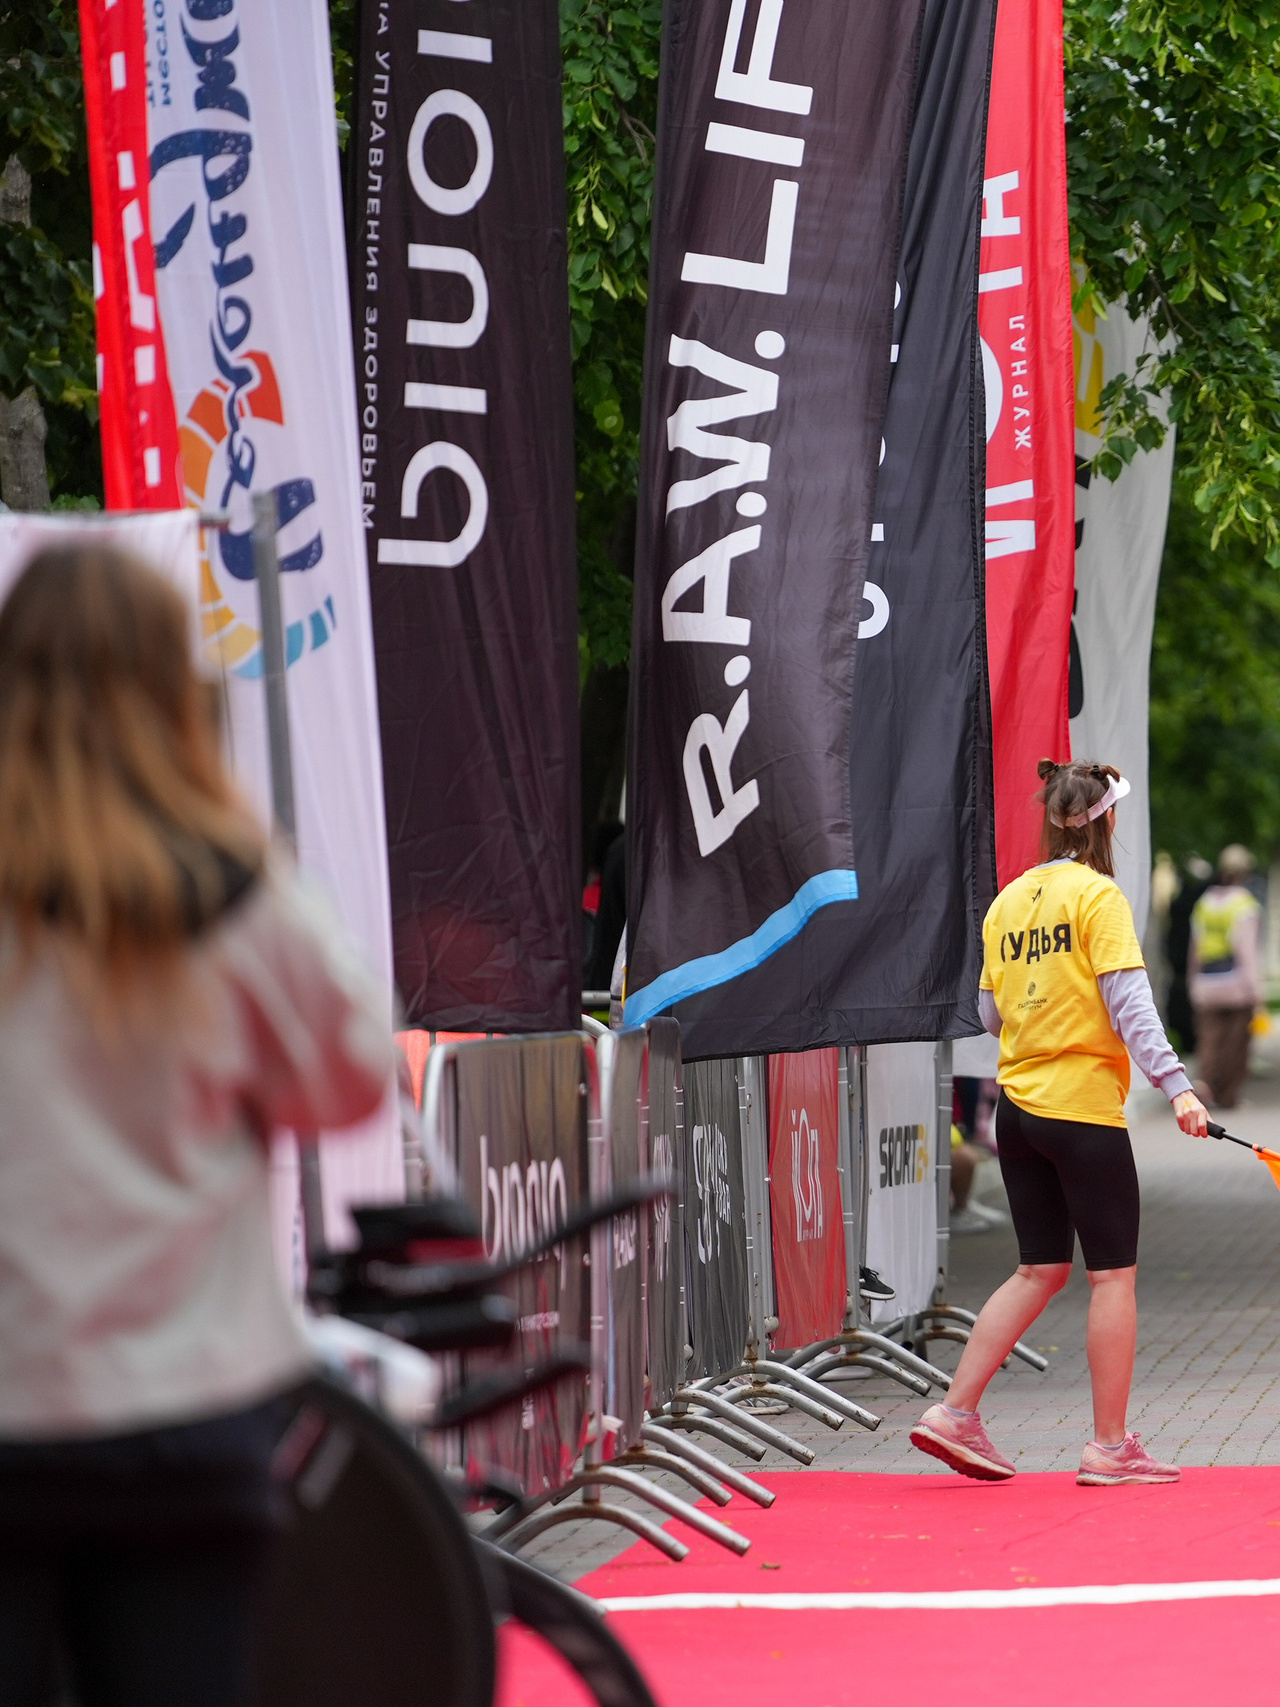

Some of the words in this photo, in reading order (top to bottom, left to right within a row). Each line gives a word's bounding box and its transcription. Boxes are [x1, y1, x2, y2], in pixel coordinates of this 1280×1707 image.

[377, 0, 391, 36] А
[365, 50, 391, 291] УПРАВЛЕНИЯ
[376, 0, 494, 568] ioniq
[1008, 313, 1032, 451] ЖУРНАЛ
[359, 305, 379, 530] ЗДОРОВЬЕМ
